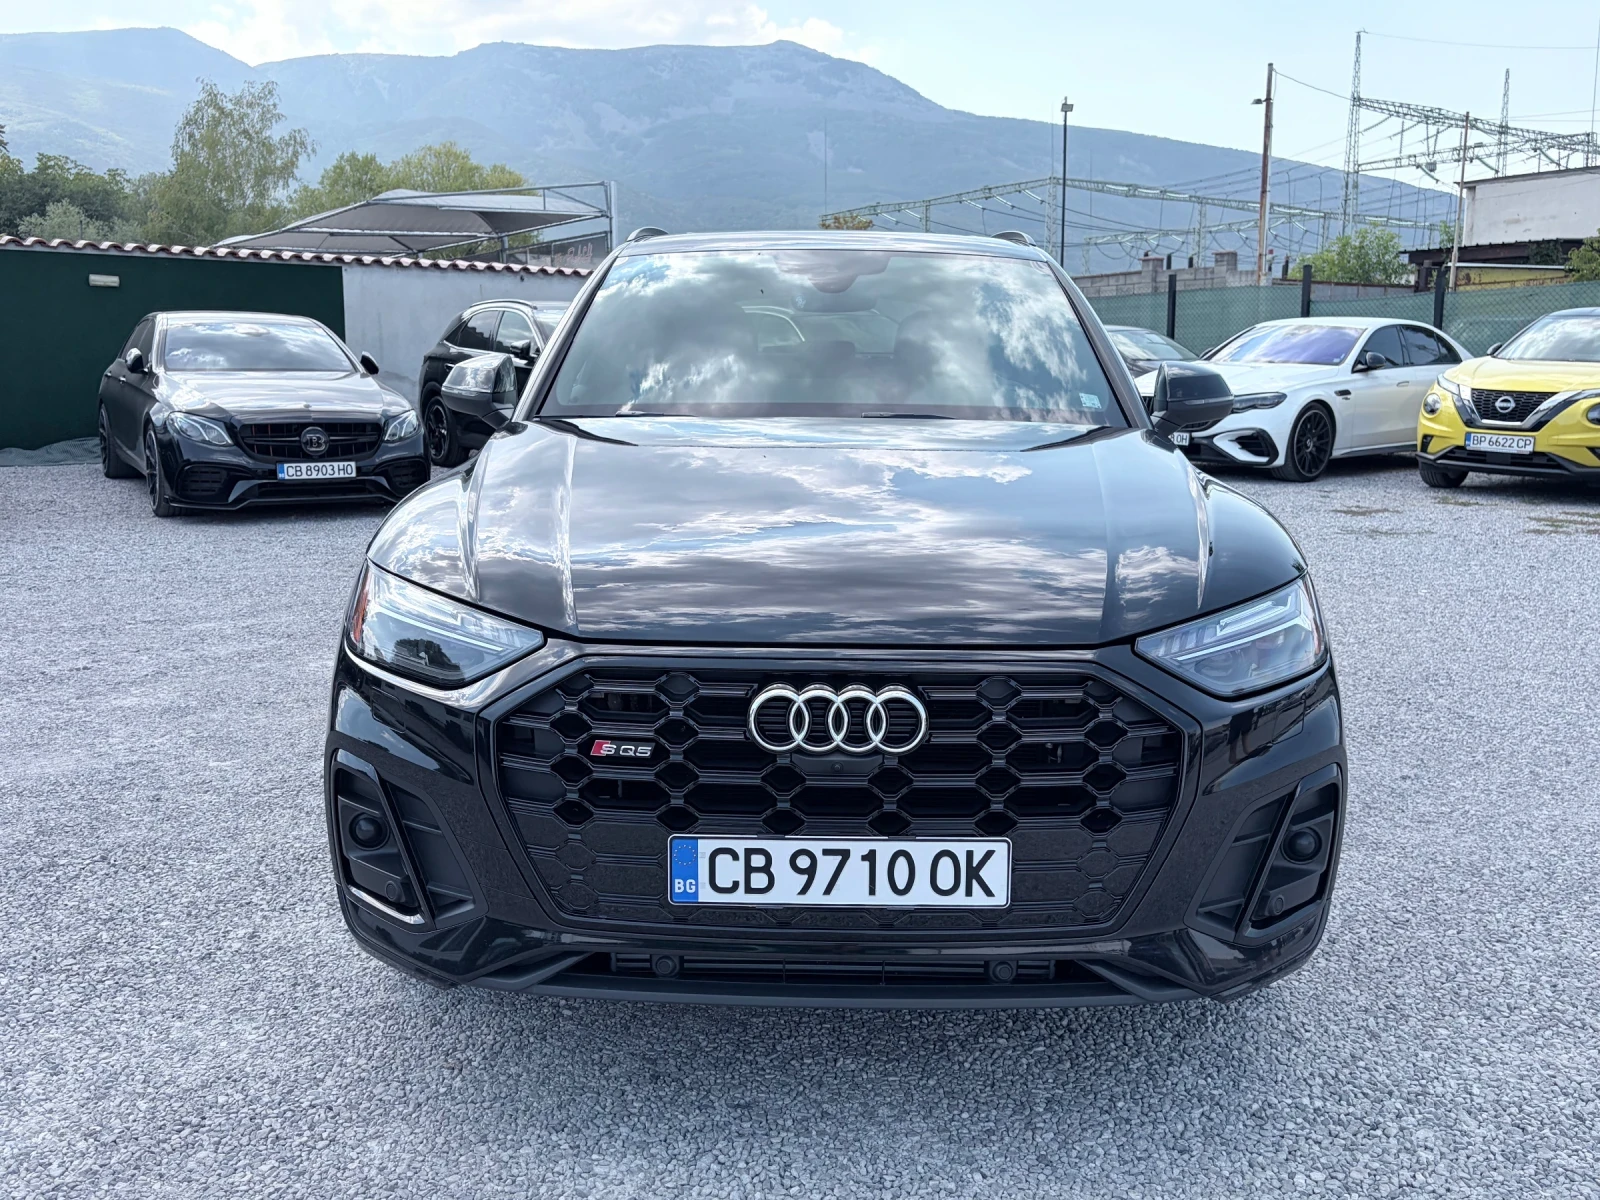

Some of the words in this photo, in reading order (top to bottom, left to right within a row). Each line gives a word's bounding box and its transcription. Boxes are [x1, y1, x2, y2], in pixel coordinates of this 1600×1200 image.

[1472, 435, 1487, 446] BP
[1488, 436, 1515, 449] 6622
[1516, 438, 1532, 449] CP
[286, 465, 303, 478] CB
[305, 464, 336, 477] 8903
[708, 847, 775, 895] CB
[788, 848, 916, 896] 9710
[929, 849, 996, 898] OK
[674, 878, 696, 893] BG
